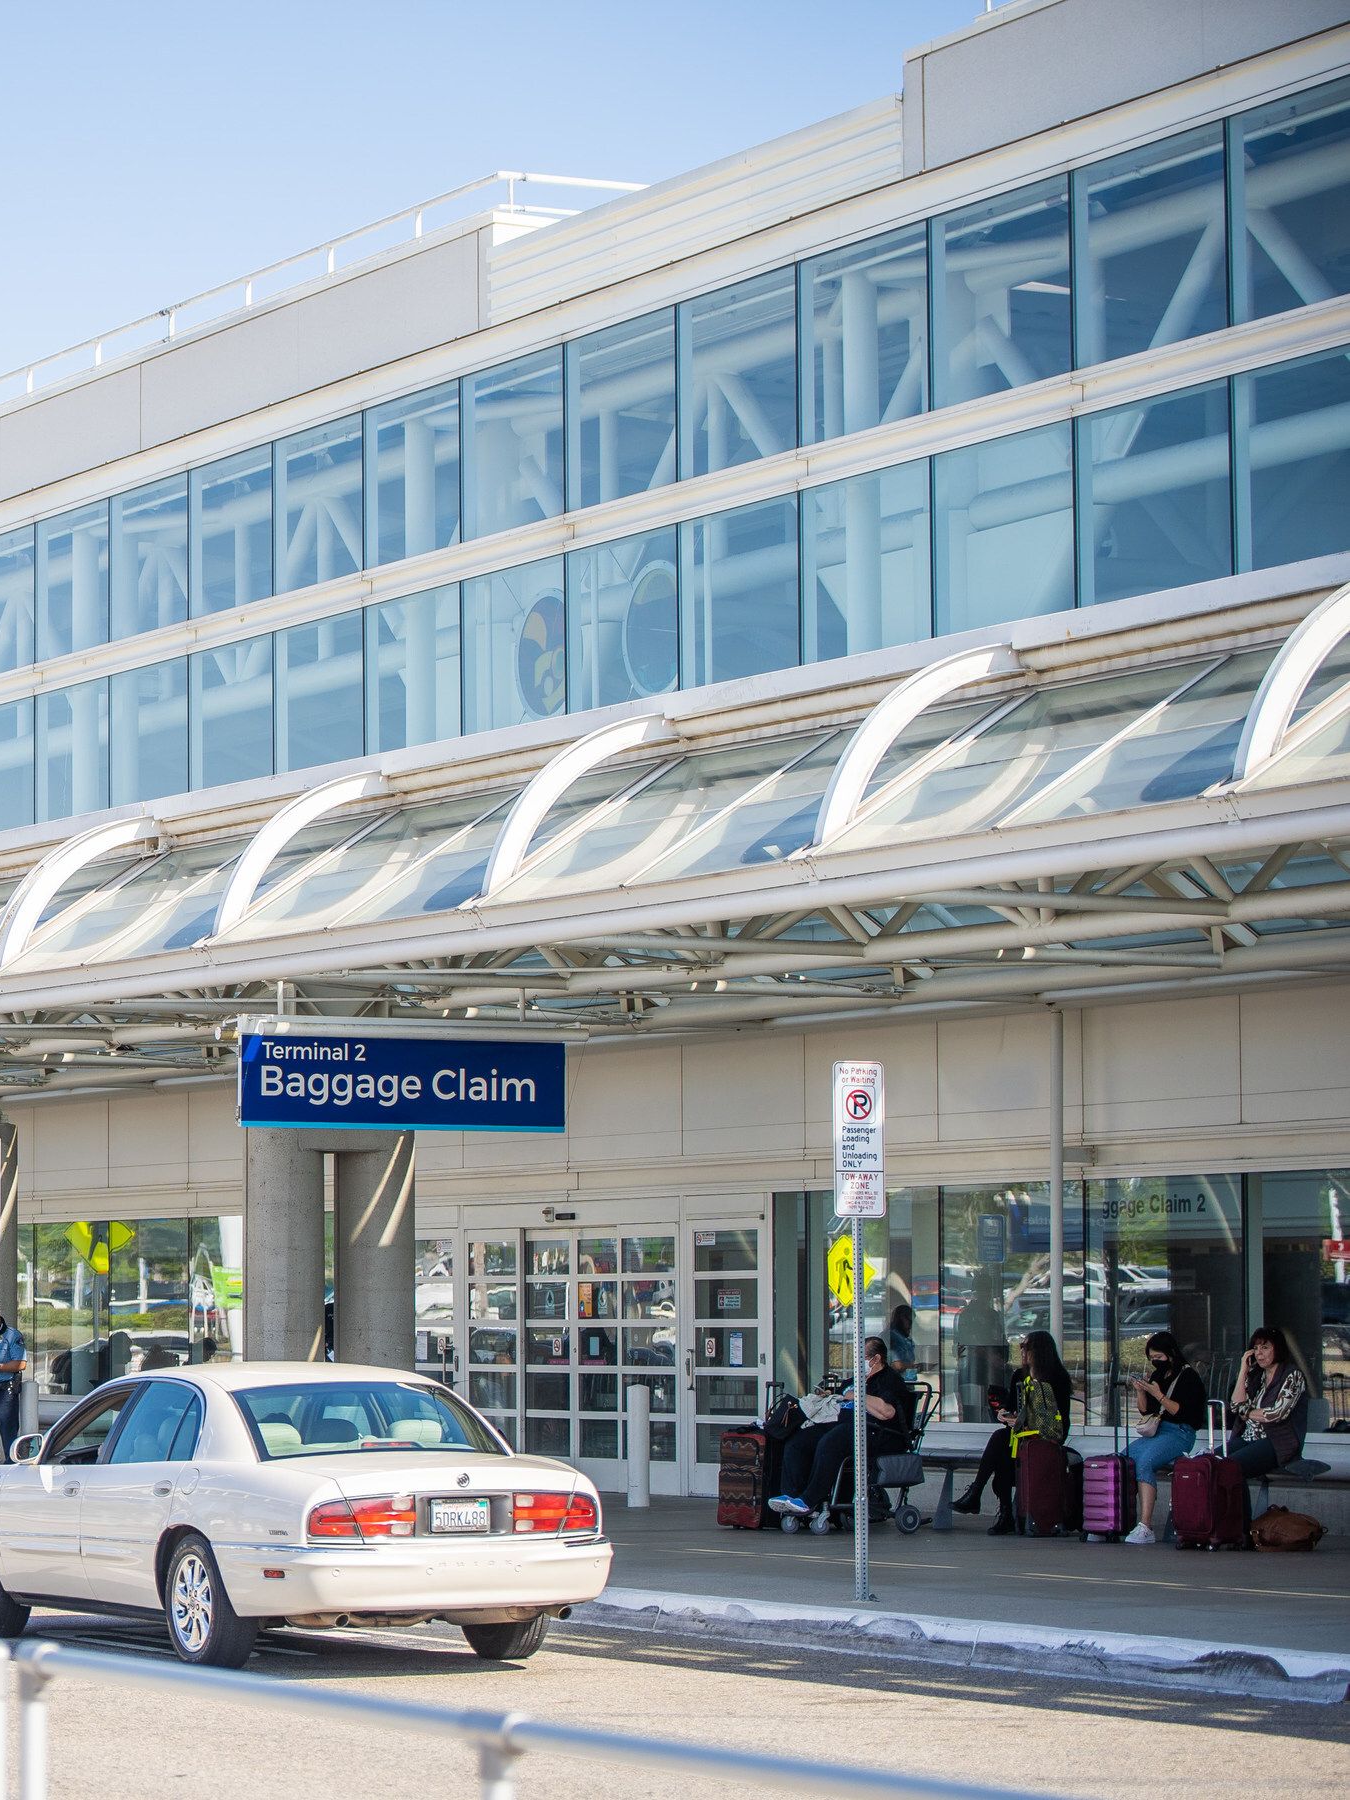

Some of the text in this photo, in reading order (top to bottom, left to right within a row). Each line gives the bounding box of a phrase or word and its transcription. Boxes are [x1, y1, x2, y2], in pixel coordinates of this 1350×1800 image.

[262, 1041, 366, 1062] Terminal 2
[839, 1067, 878, 1078] No Parking
[260, 1064, 536, 1107] Baggage Claim
[850, 1077, 875, 1087] Waiting
[841, 1126, 877, 1135] Passenger
[841, 1135, 870, 1144] Loading
[841, 1152, 878, 1161] Unloading
[841, 1160, 863, 1168] ONLY
[840, 1173, 879, 1181] TOW-AWAY
[850, 1182, 870, 1190] ZONE
[1150, 1193, 1192, 1214] Claim
[1196, 1193, 1206, 1213] 2
[435, 1510, 486, 1527] 5DRK488
